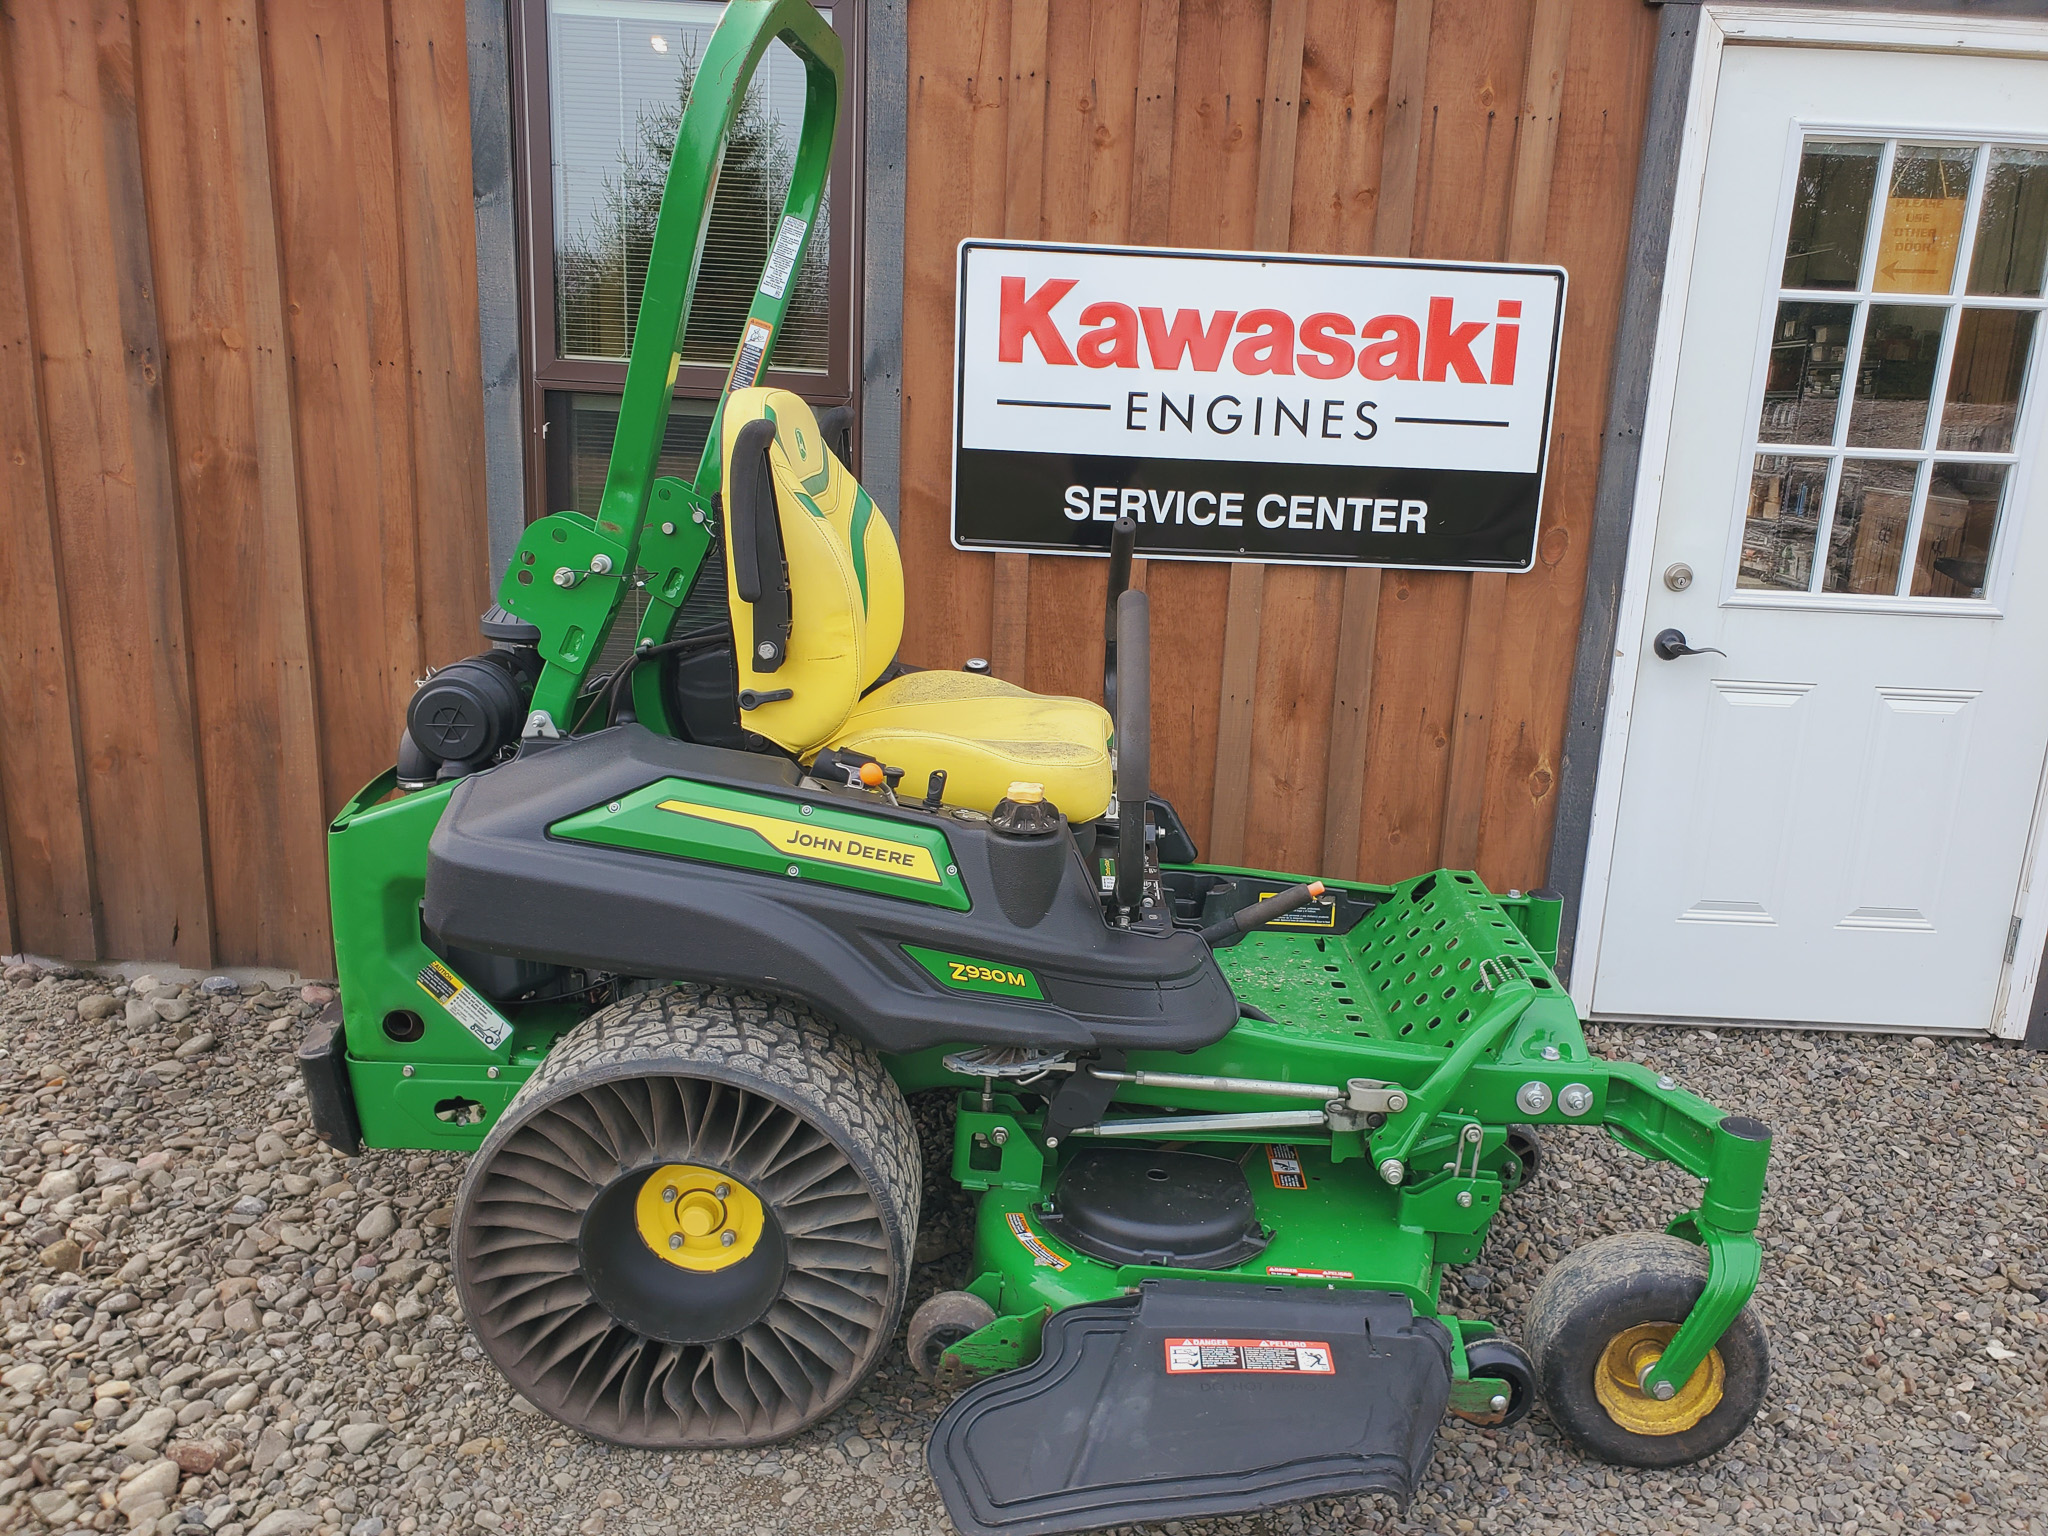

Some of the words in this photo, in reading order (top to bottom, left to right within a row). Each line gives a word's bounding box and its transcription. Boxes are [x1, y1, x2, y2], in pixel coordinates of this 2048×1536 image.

[1895, 198, 1944, 208] PLEASE
[1905, 213, 1931, 223] USE
[1893, 227, 1937, 238] OTHER
[1894, 242, 1933, 252] DOOR
[998, 275, 1522, 386] Kawasaki
[1126, 391, 1379, 441] ENGINES
[1063, 484, 1244, 528] SERVICE
[1255, 492, 1428, 534] CENTER
[786, 829, 843, 853] JOHN
[846, 840, 916, 867] DEERE
[432, 961, 454, 981] CAUTION
[948, 961, 1027, 988] Z930M
[862, 1166, 898, 1233] MICHELIN
[1200, 1382, 1225, 1392] DO
[1232, 1382, 1264, 1392] NOT
